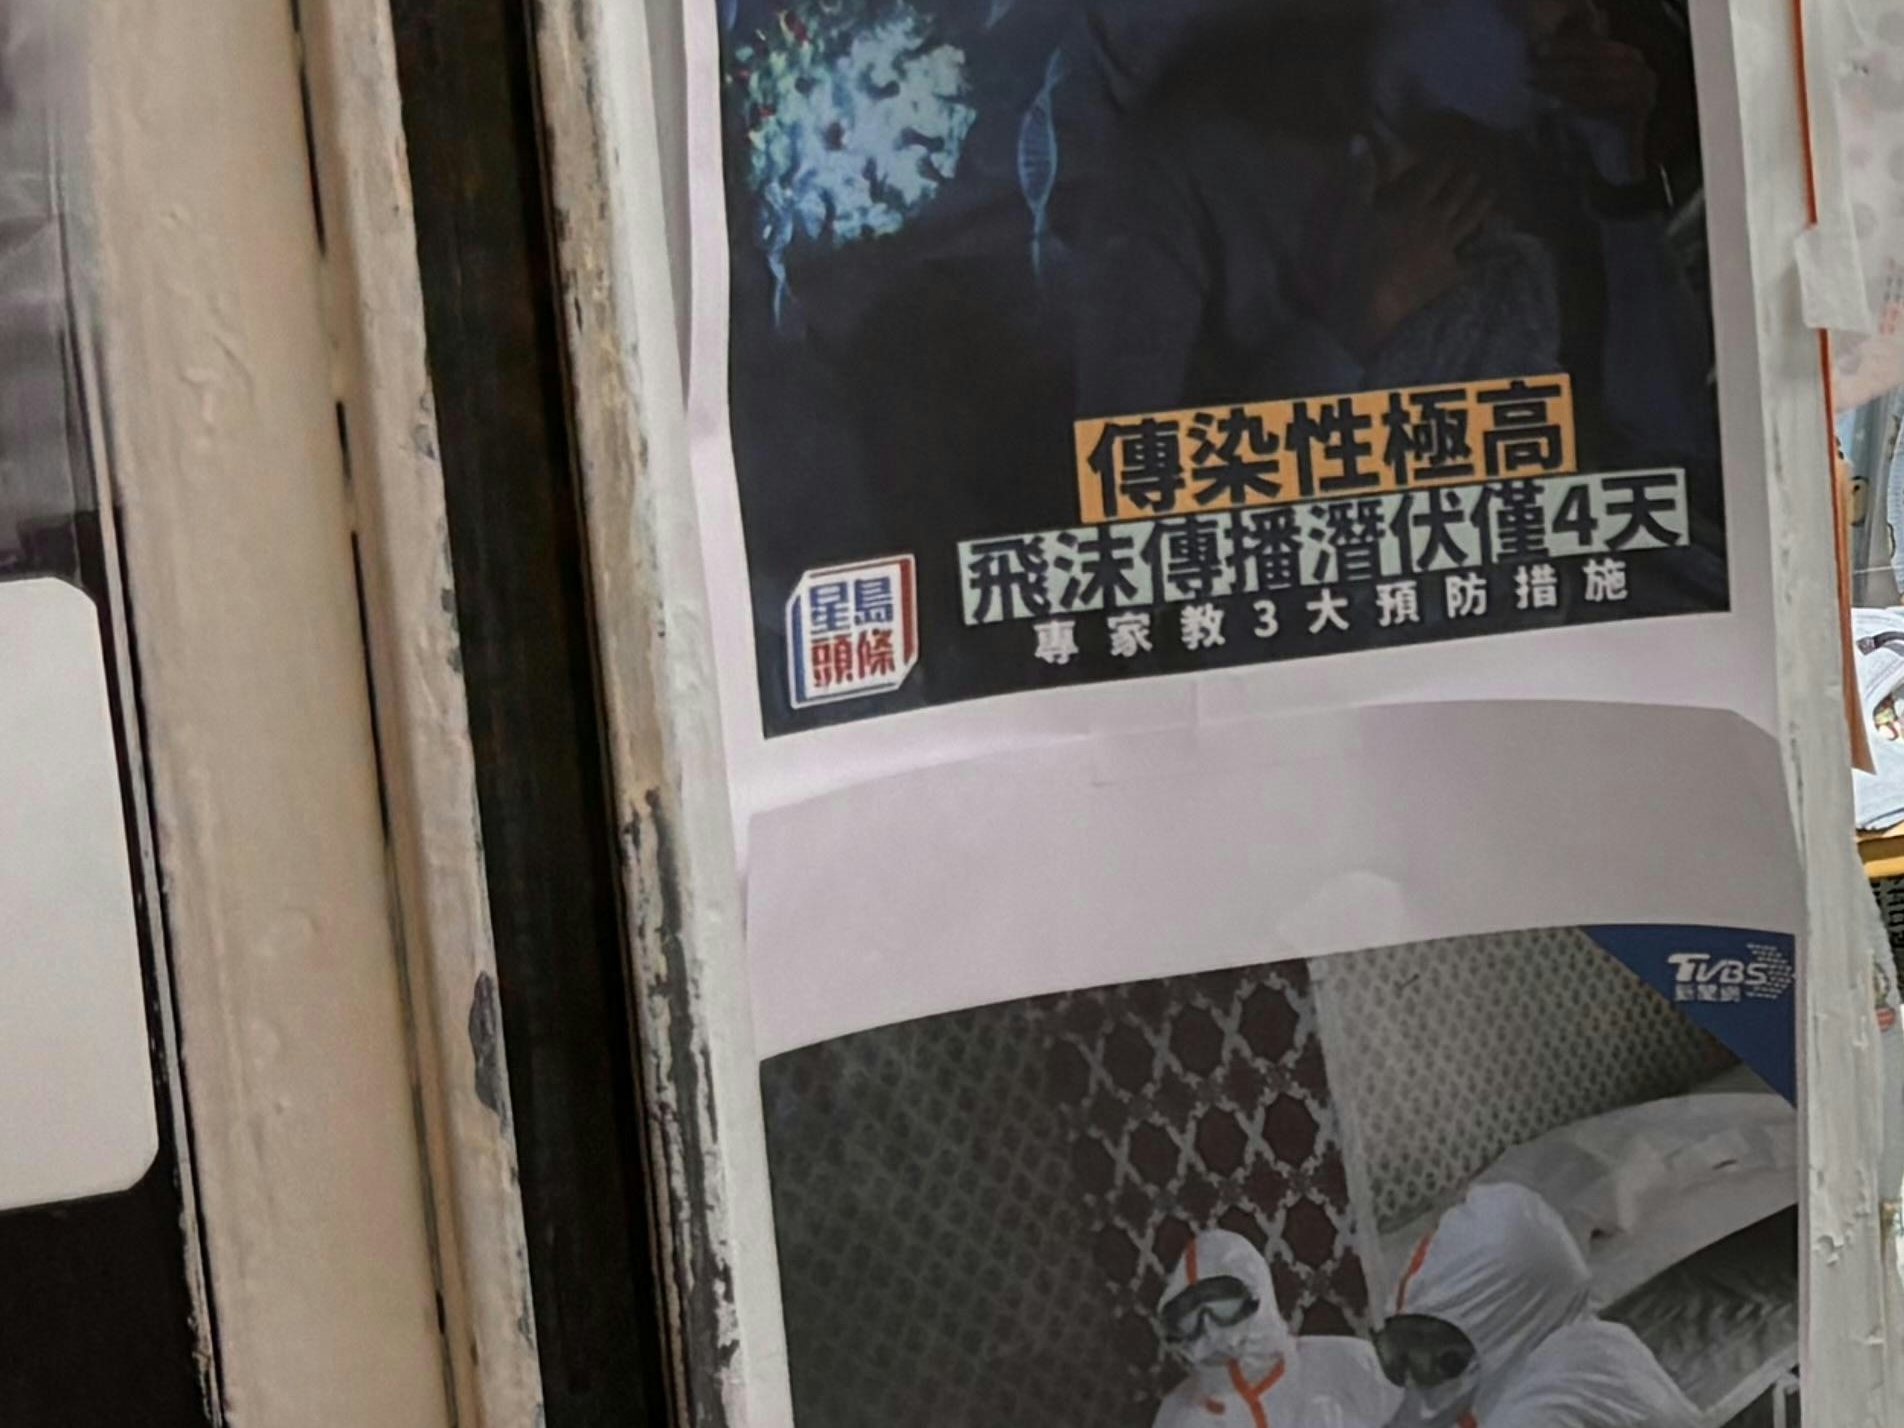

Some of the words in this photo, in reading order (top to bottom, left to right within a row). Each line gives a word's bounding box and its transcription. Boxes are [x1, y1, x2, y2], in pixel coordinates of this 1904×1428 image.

[1086, 378, 1564, 519] 傳染性極高
[966, 468, 1685, 627] 飛沫傳播潛伏僅4天
[812, 626, 898, 690] 頭條
[1033, 558, 1629, 667] 專家教3大預防措施
[1667, 953, 1767, 986] TVBS
